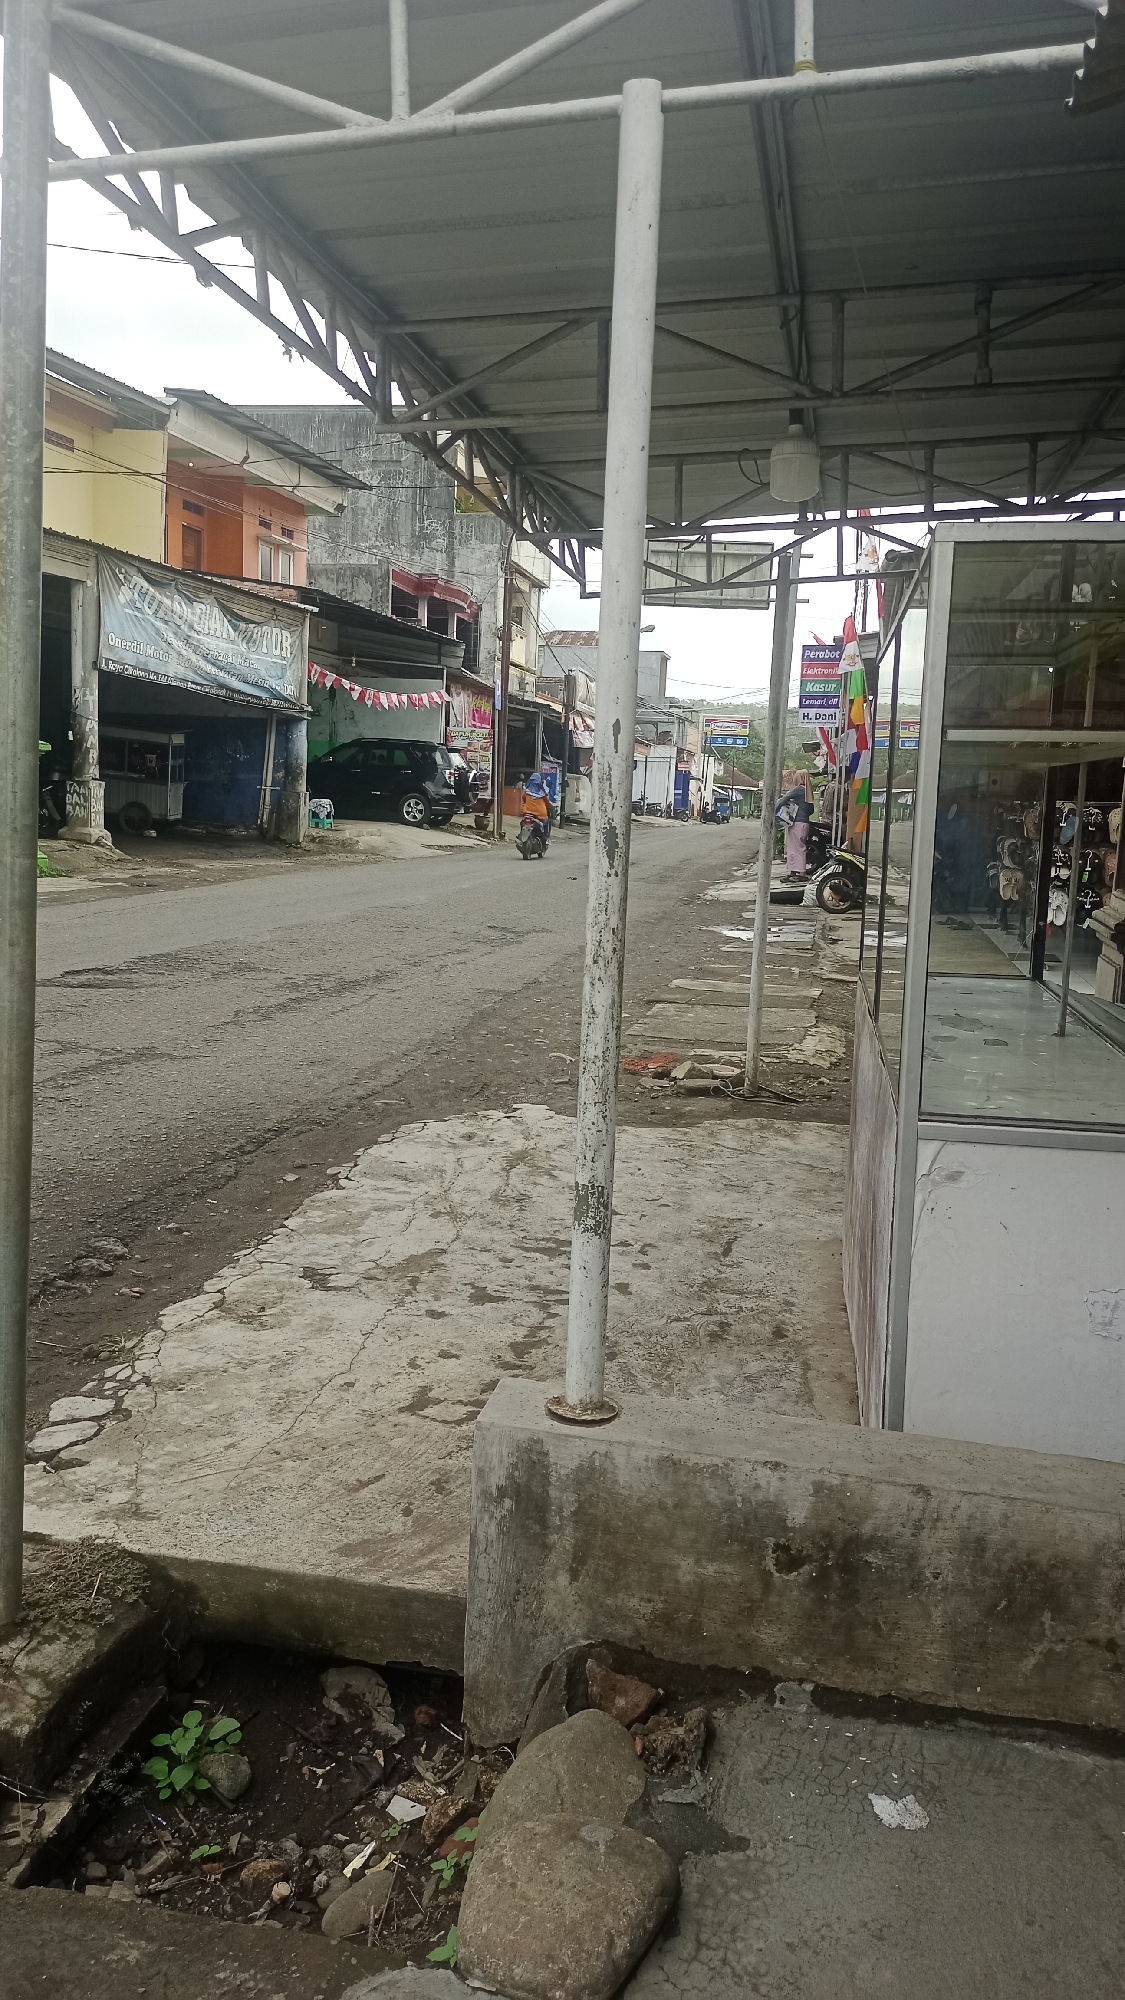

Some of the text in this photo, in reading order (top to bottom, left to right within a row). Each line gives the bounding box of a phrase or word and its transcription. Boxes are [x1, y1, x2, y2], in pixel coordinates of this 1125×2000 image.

[803, 649, 841, 659] Perabot
[805, 682, 837, 692] Kasur
[802, 711, 837, 721] H. Dani
